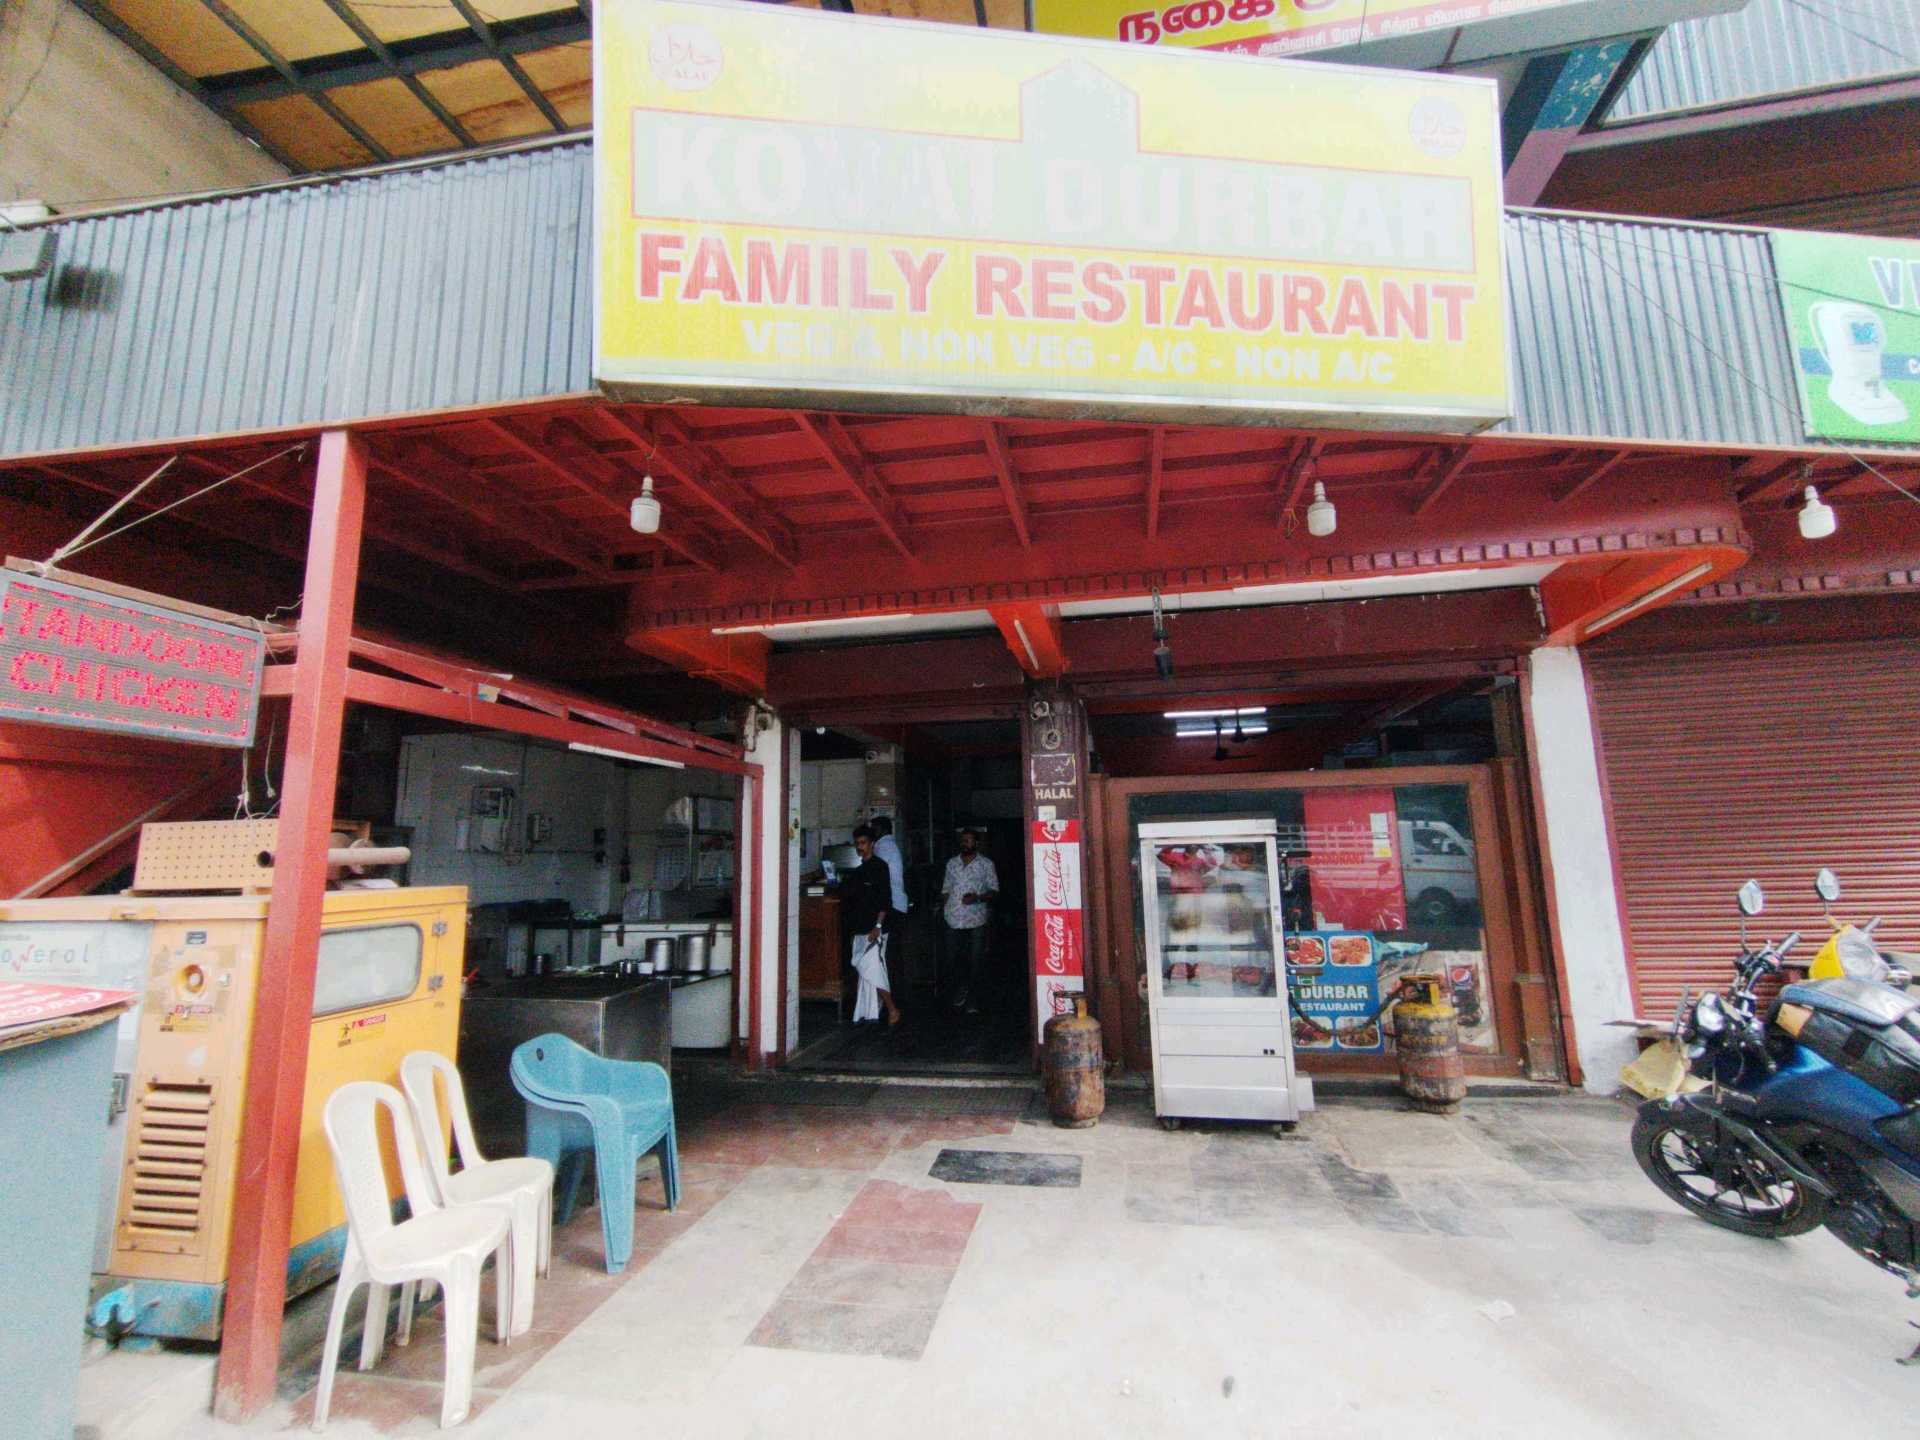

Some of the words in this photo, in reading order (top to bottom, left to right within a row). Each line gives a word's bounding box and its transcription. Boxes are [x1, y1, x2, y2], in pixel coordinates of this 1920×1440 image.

[1045, 159, 1463, 259] DURBAR
[640, 233, 946, 313] FAMILY
[975, 255, 1474, 341] RESTAURANT
[741, 320, 833, 358] VEG
[901, 327, 994, 367] NON
[1008, 334, 1096, 370] VEG
[1132, 340, 1198, 375] A/C
[1235, 345, 1320, 381] NON
[1333, 351, 1394, 385] A/C
[9, 650, 240, 720] CHICKEN
[1034, 787, 1075, 800] HALAL
[1298, 1002, 1366, 1012] ESTAURANT
[1300, 985, 1369, 999] DURBAR
